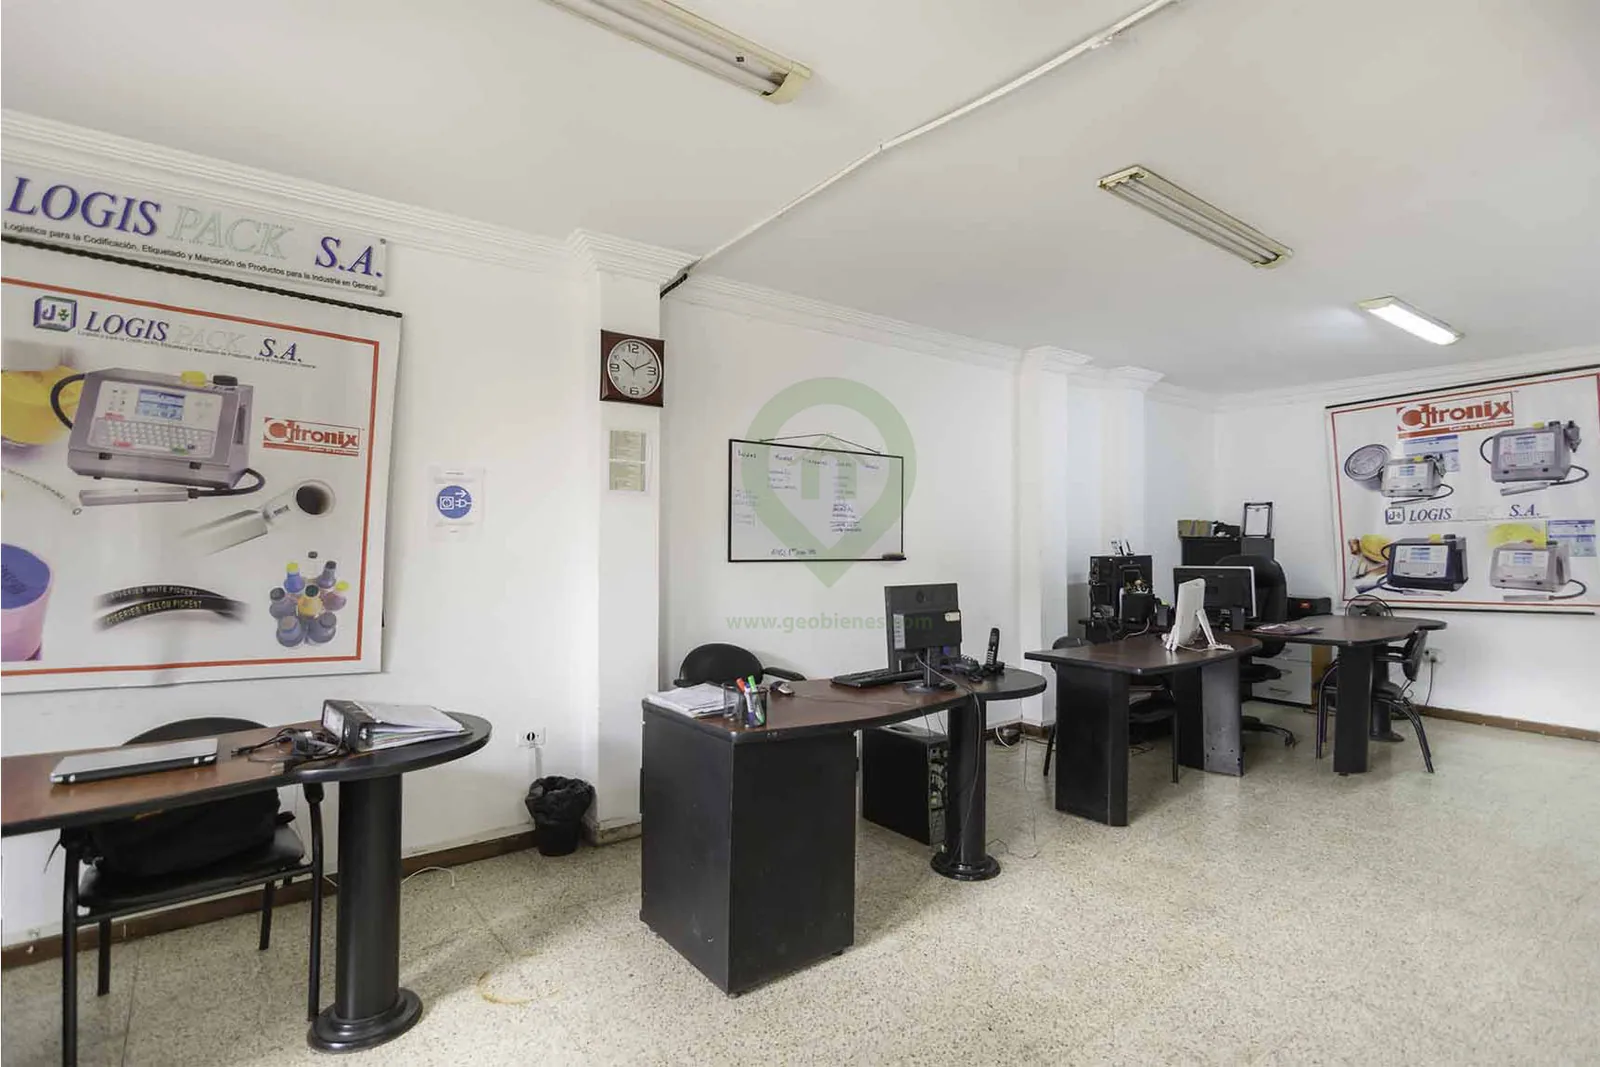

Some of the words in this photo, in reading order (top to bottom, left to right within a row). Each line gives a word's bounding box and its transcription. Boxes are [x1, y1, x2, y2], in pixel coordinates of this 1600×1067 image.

[6, 176, 162, 236] LOGIS
[166, 205, 294, 260] PACK
[314, 236, 383, 278] S.A.
[49, 230, 70, 240] para
[73, 233, 81, 241] la
[142, 244, 186, 259] Etiquetado
[188, 253, 193, 261] y
[248, 262, 285, 276] Productos
[286, 269, 303, 280] para
[84, 311, 169, 342] LOGIS
[259, 338, 303, 362] S.A.
[628, 343, 639, 354] 12
[646, 366, 656, 376] 3
[630, 386, 639, 395] 6
[1409, 508, 1452, 522] LOGIS
[1509, 504, 1540, 517] S.A.
